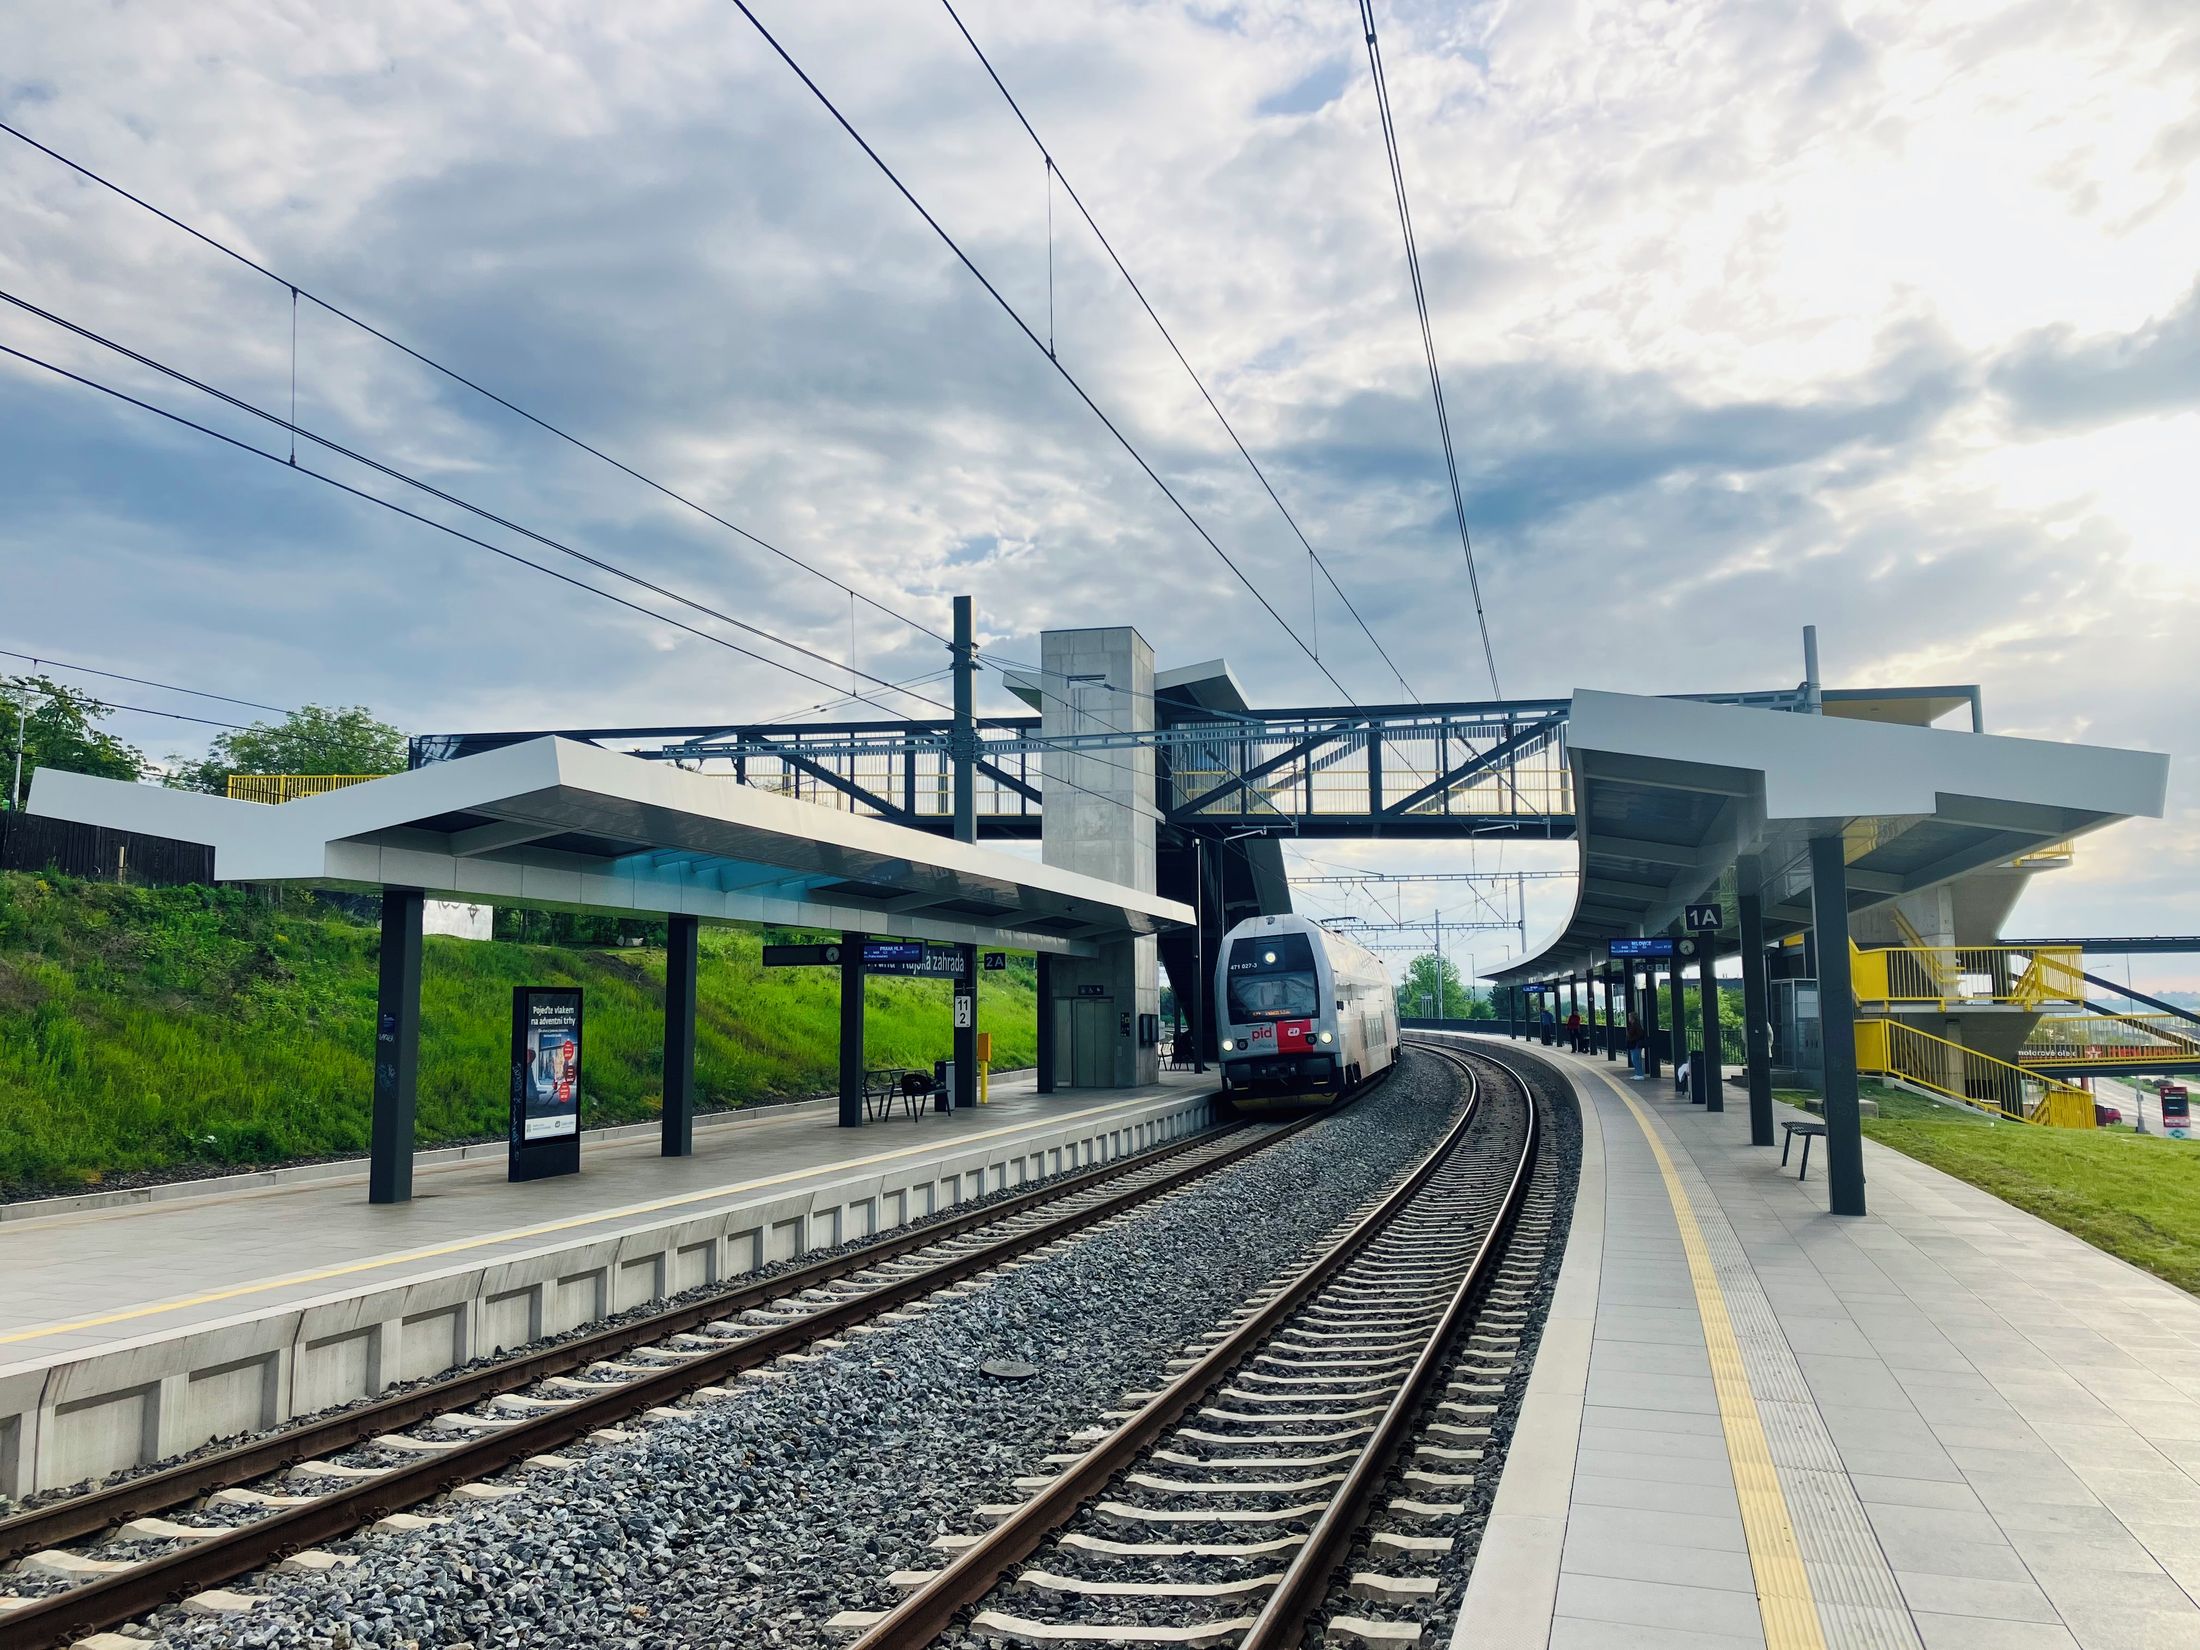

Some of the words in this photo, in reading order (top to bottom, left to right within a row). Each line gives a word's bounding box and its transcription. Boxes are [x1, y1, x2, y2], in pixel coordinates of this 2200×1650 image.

[1689, 909, 1718, 926] 1A
[933, 951, 965, 972] zahrada
[986, 956, 1004, 967] 2A
[554, 1005, 575, 1014] vlakem
[957, 999, 968, 1011] 11
[539, 1016, 563, 1025] adventní
[563, 1016, 576, 1026] trhy
[959, 1012, 966, 1024] 2
[1251, 1027, 1272, 1042] pid
